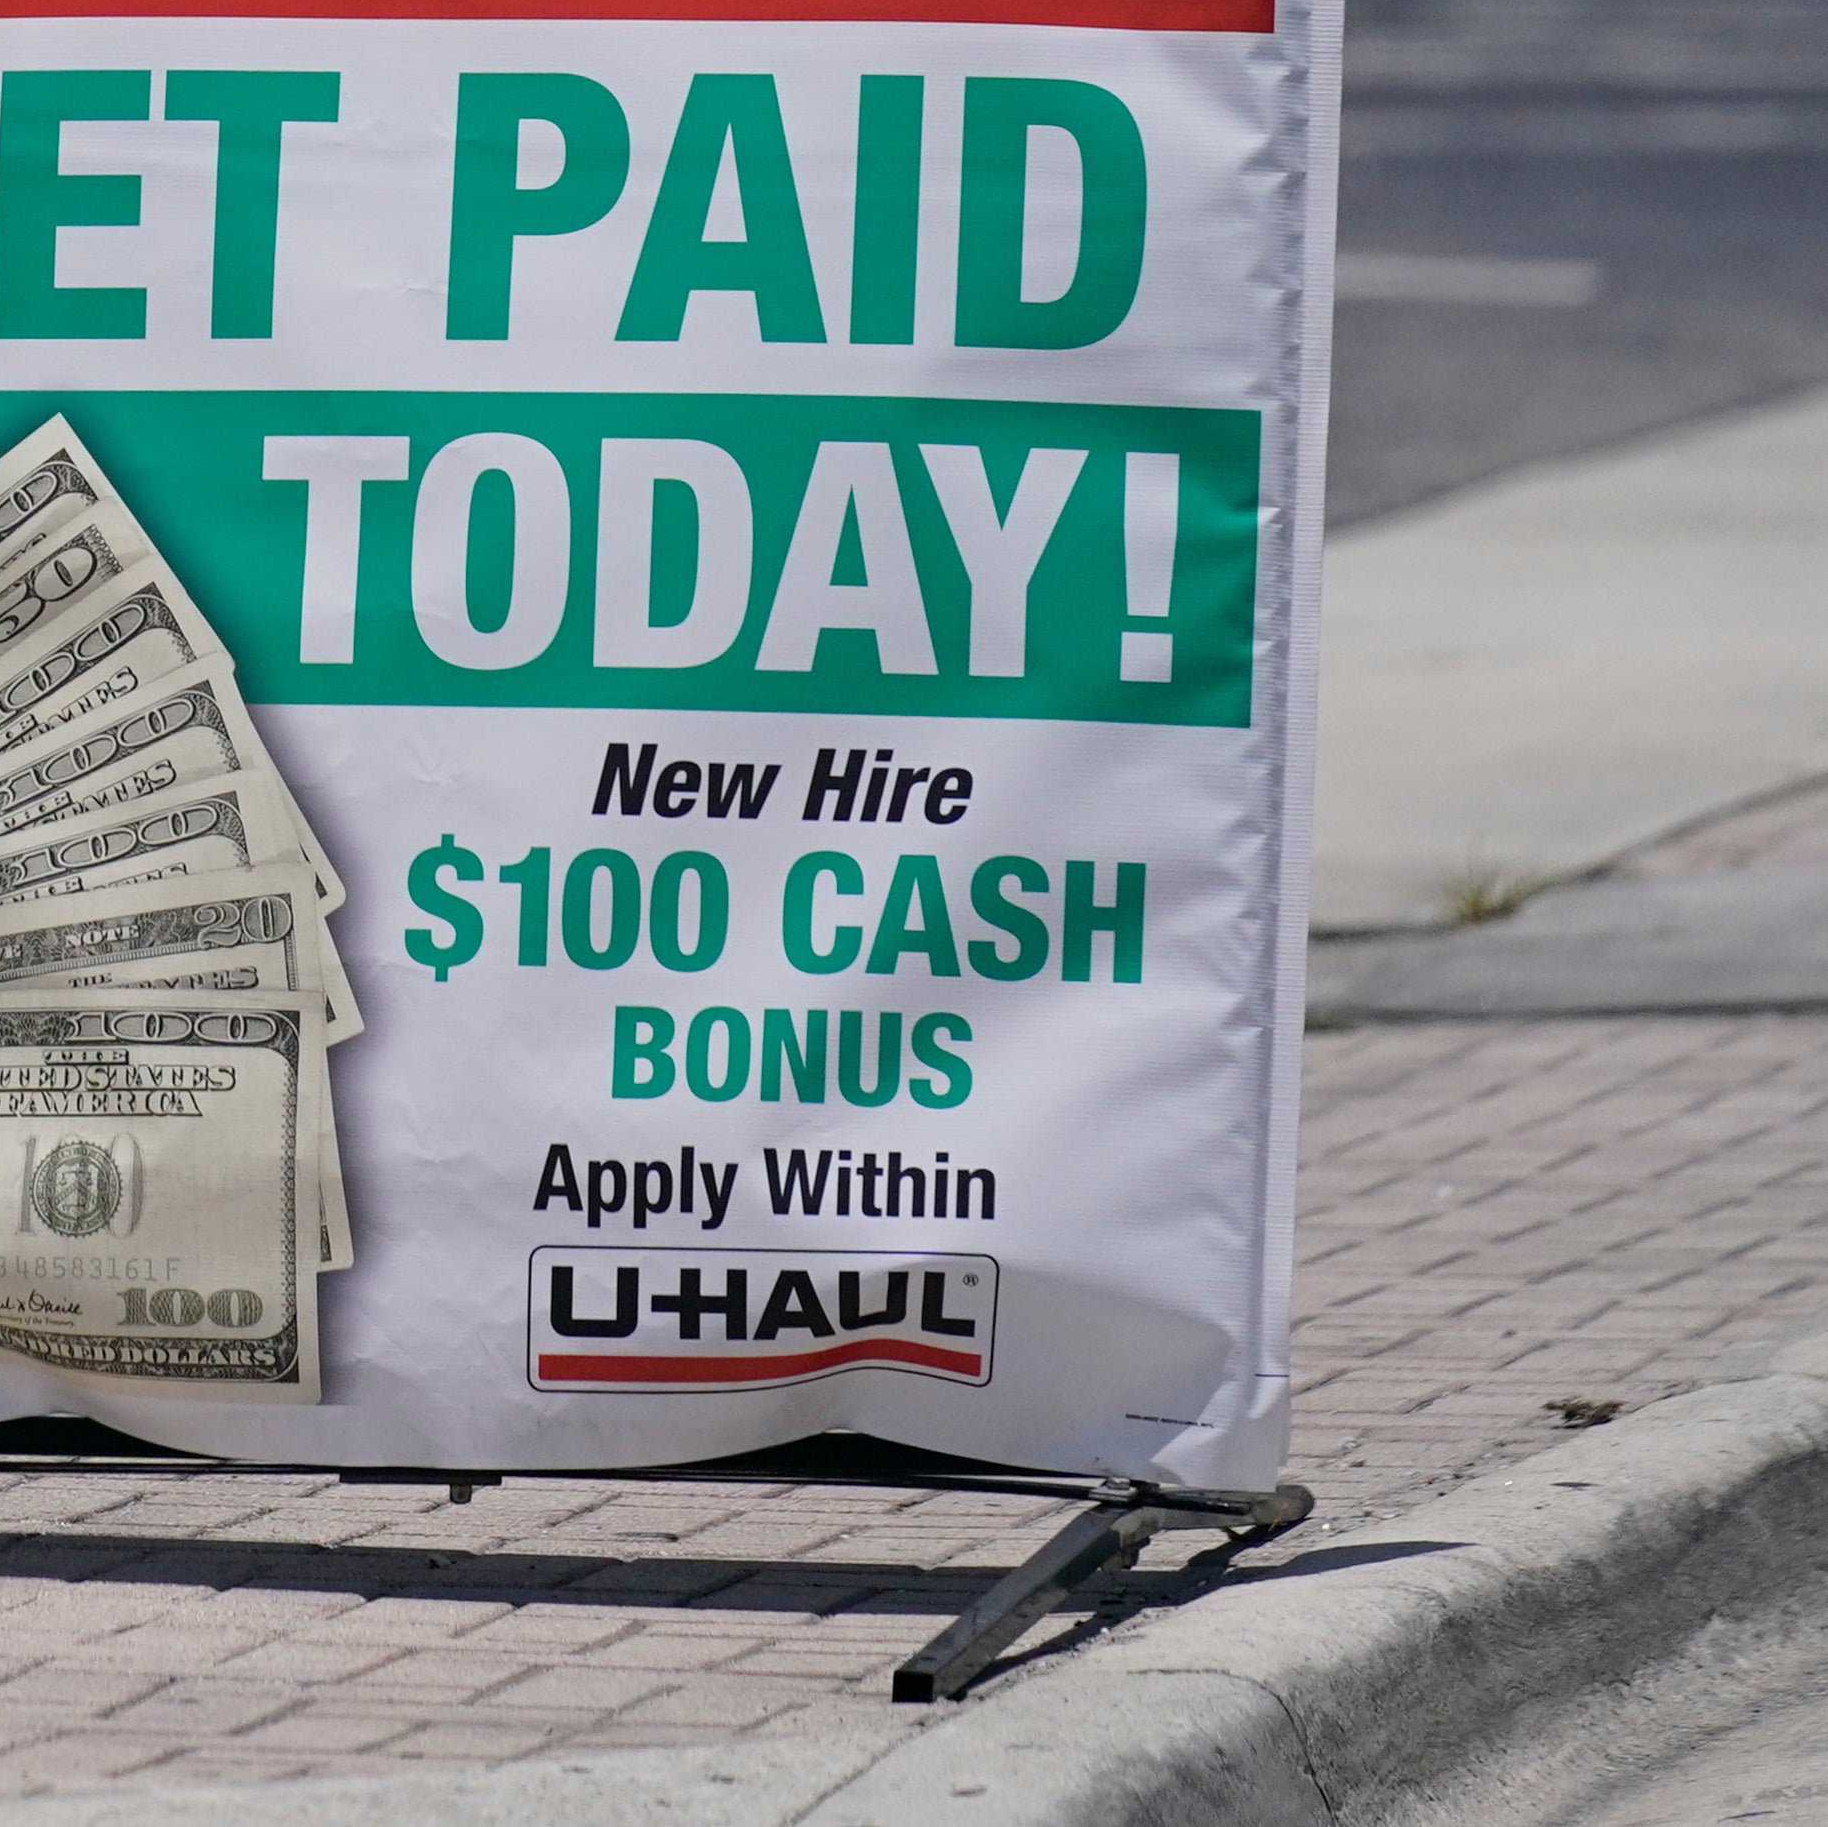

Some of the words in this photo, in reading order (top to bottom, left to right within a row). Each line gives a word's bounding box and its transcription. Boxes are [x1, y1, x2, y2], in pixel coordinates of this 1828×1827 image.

[446, 74, 1147, 350] PAID
[263, 433, 1179, 682] TODAY!
[592, 742, 781, 819] New
[801, 748, 974, 825] Hire
[10, 802, 219, 886] 100
[64, 924, 141, 951] NOTE
[194, 895, 294, 951] 20
[405, 834, 729, 983] $100
[781, 849, 1148, 985] CASH
[65, 1011, 278, 1044] 100
[611, 1005, 974, 1110] BONUS
[23, 1090, 203, 1118] AMERICA
[84, 1065, 236, 1092] STATES
[534, 1142, 739, 1230] Apply
[763, 1148, 996, 1220] Within
[116, 1287, 265, 1329] 100
[119, 1345, 277, 1367] DOLLARS
